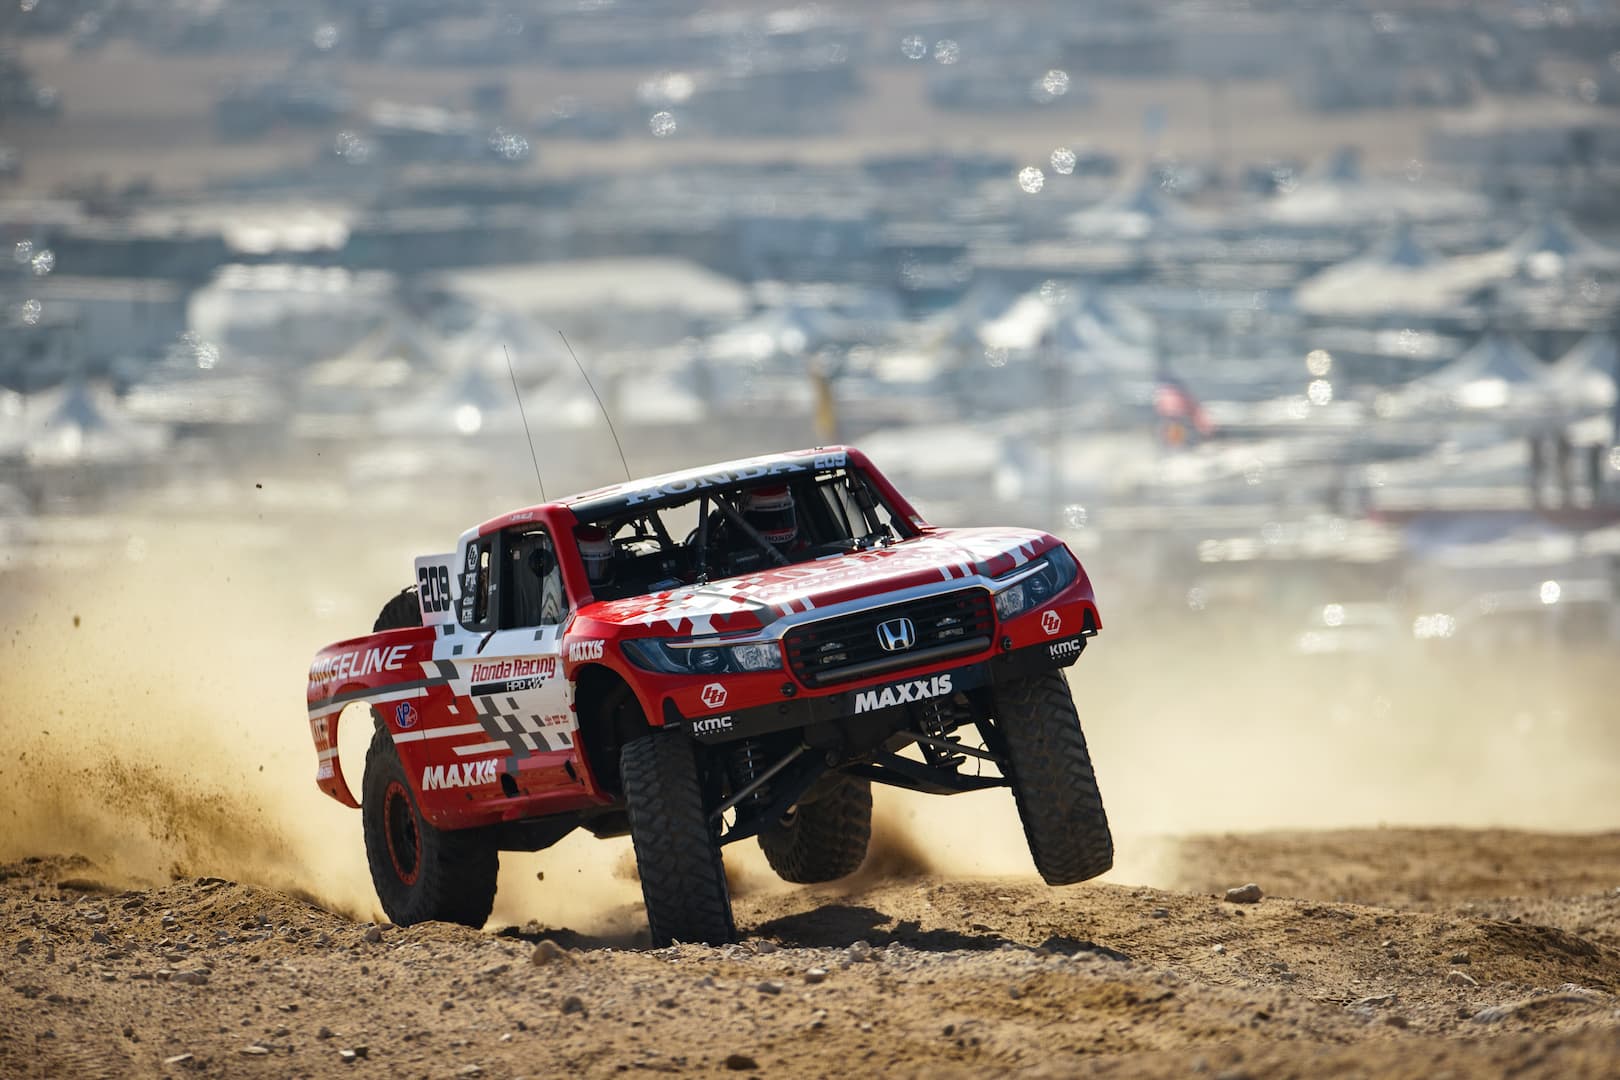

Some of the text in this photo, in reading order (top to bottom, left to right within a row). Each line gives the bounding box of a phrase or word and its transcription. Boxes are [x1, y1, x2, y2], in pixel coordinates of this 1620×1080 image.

[624, 461, 807, 506] HONDA
[419, 565, 450, 613] 209
[569, 640, 604, 662] MAXXIS
[471, 657, 556, 682] Honda Racing
[506, 680, 526, 692] HPD
[854, 674, 953, 714] MAXXIS
[422, 758, 498, 791] MAXXIS
